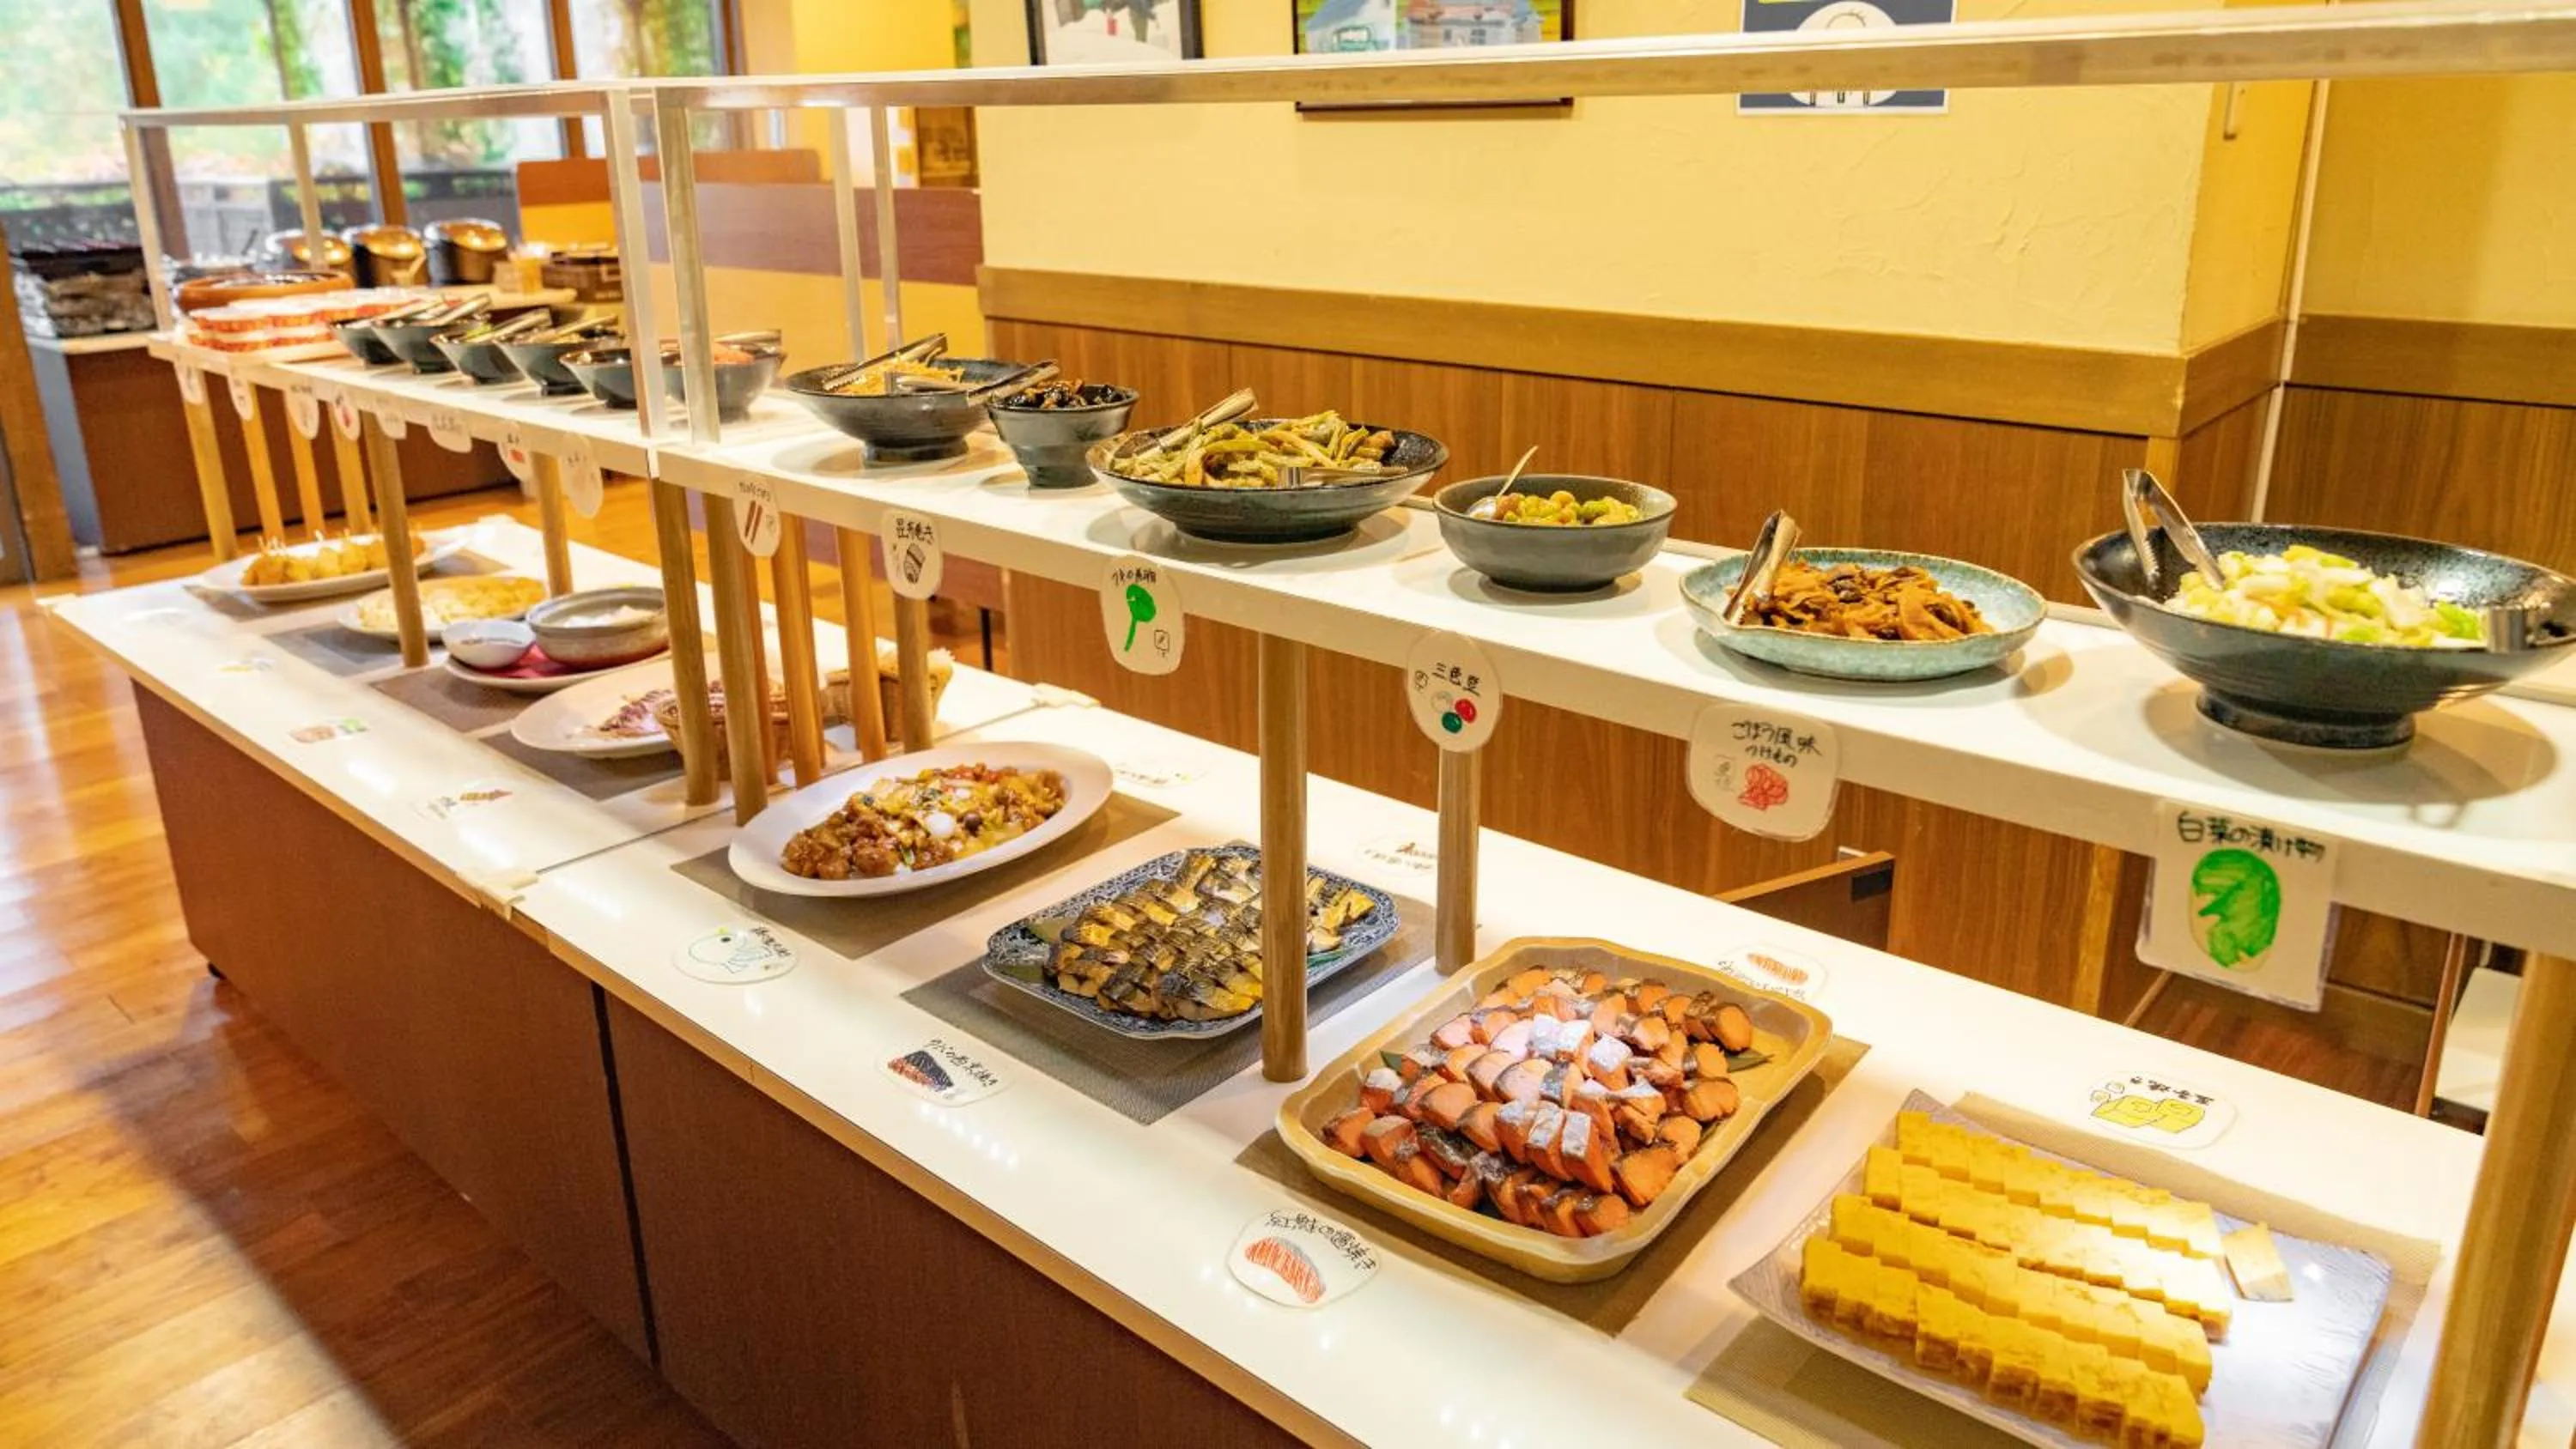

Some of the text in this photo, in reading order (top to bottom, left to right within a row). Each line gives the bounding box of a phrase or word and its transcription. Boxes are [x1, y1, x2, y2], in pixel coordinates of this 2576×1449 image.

[2178, 810, 2326, 863] 白菜の漬け物
